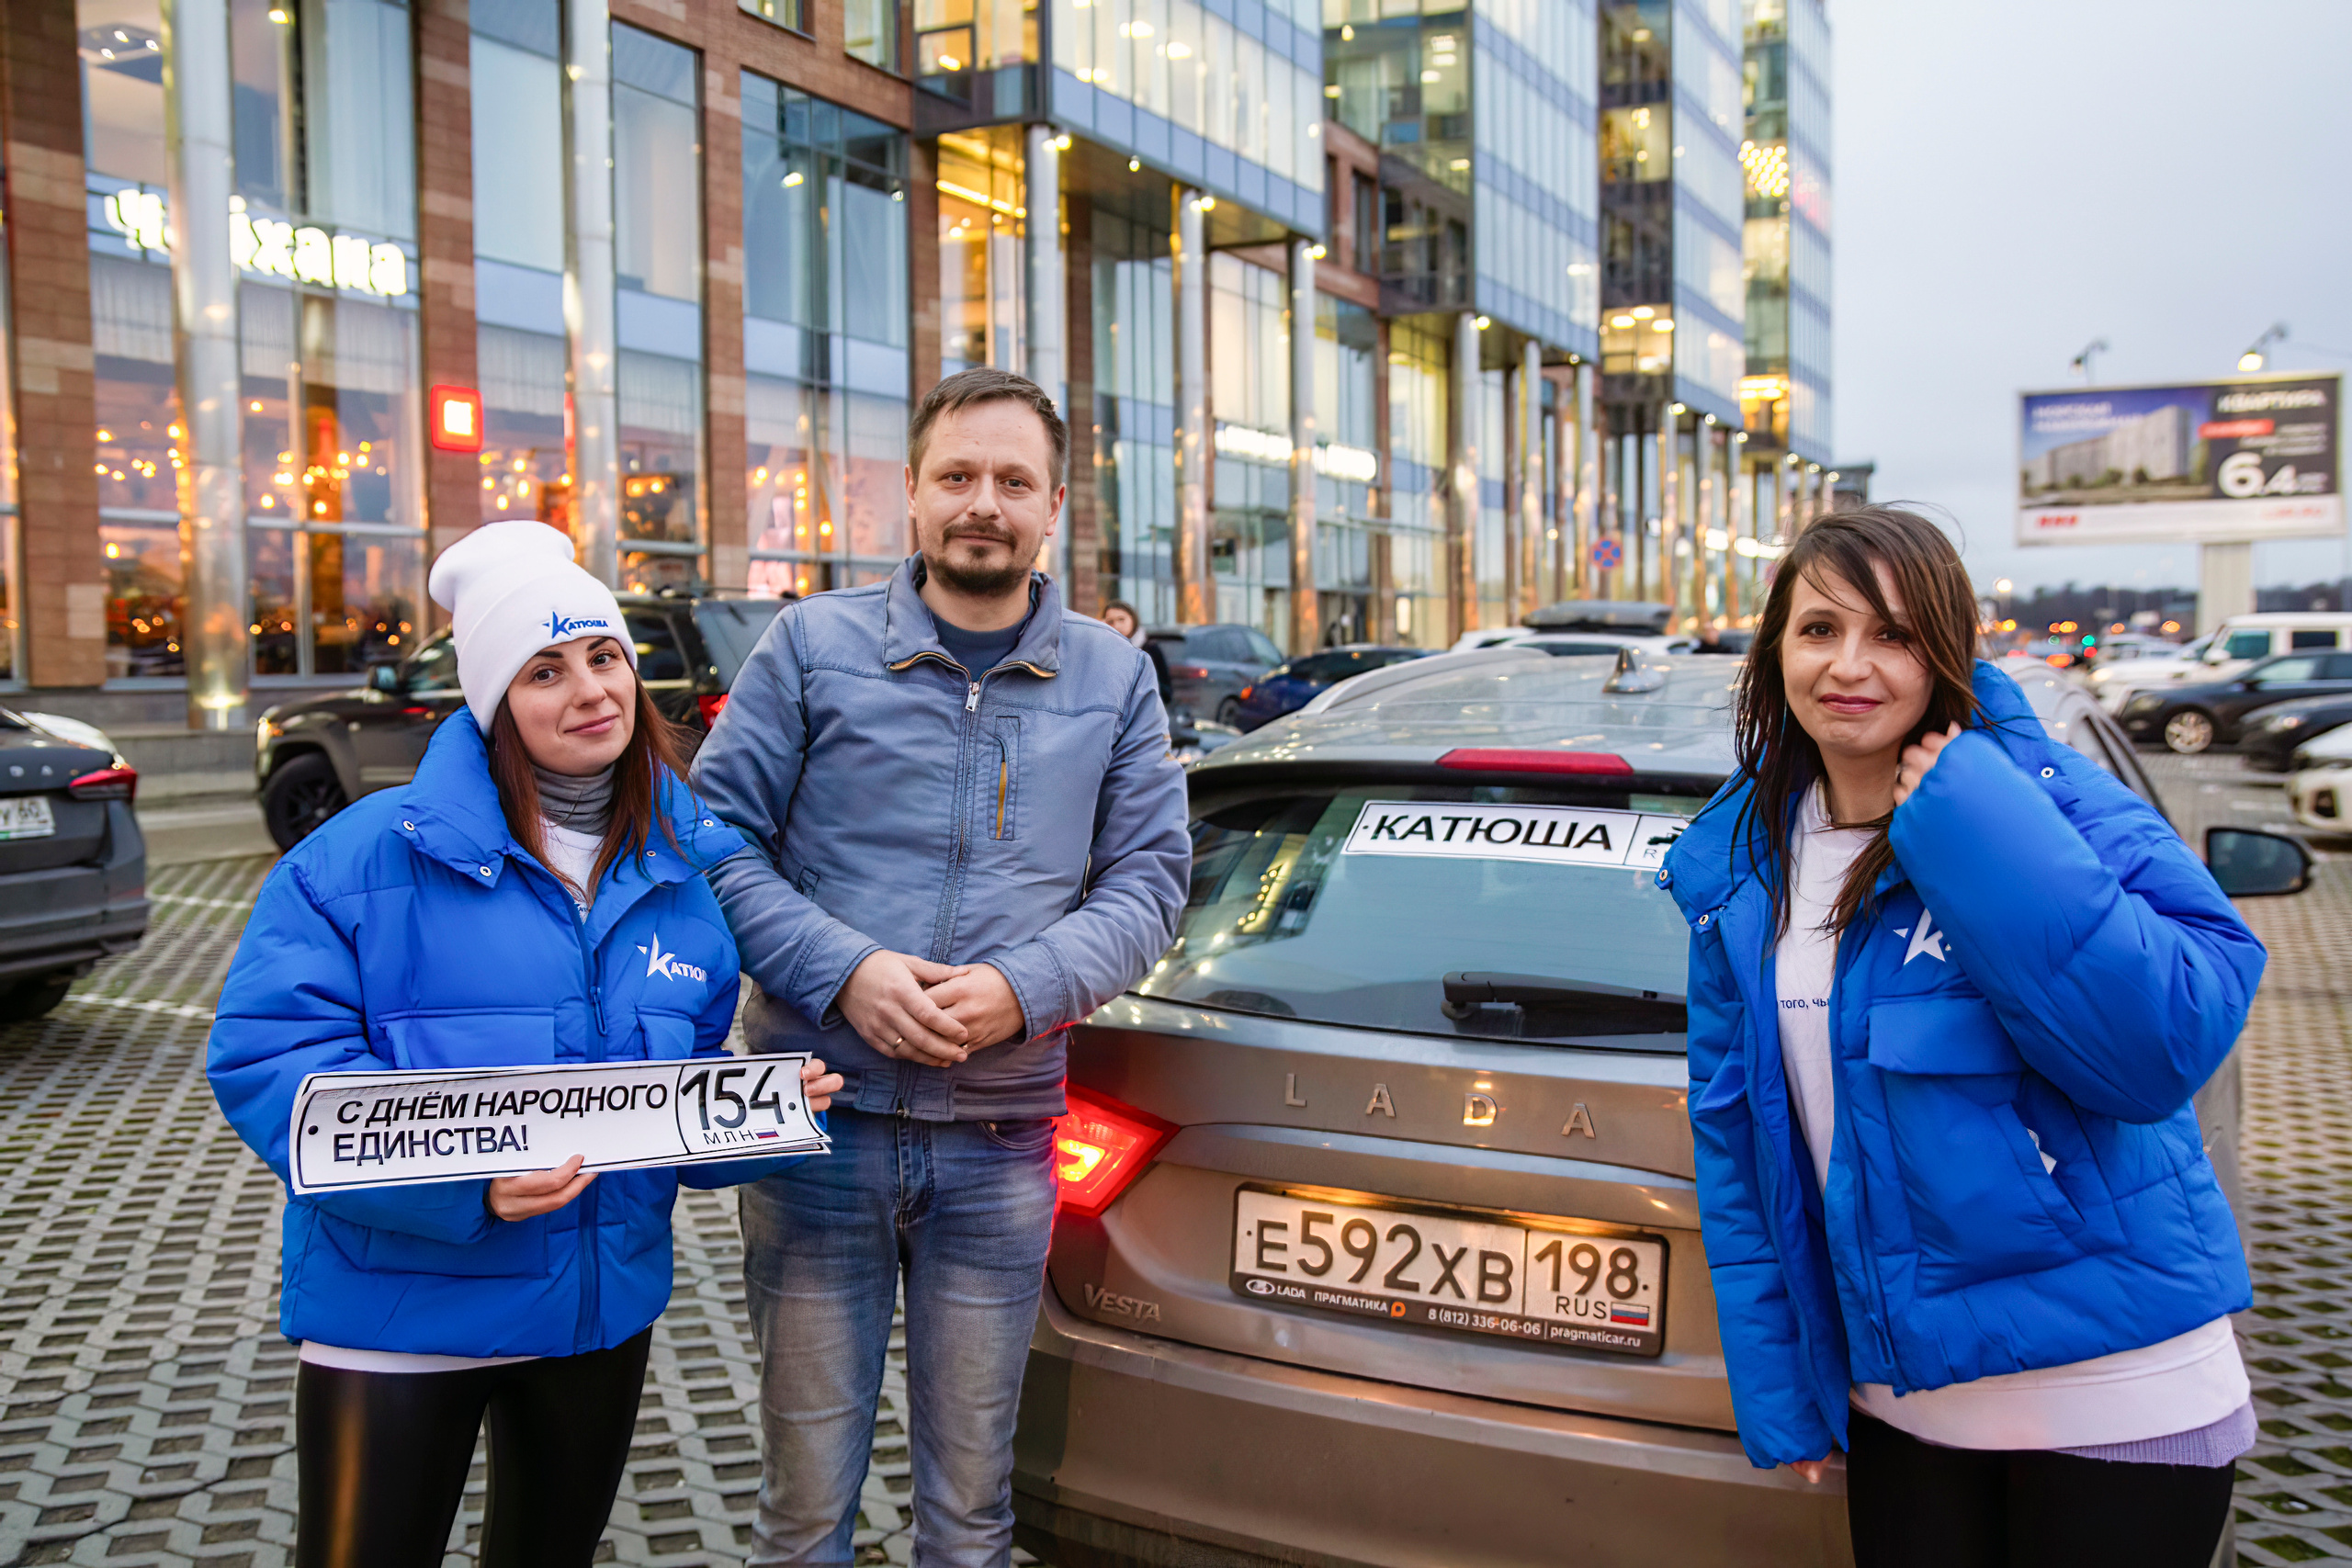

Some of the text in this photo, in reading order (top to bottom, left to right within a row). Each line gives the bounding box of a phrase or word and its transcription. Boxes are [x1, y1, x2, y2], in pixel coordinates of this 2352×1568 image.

[1370, 814, 1612, 852] КАТЮША
[1780, 998, 1809, 1010] того,
[336, 1082, 668, 1129] С ДНЁМ НАРОДНОГО
[679, 1065, 786, 1131] 154
[1285, 1072, 1597, 1140] LADA
[333, 1123, 529, 1167] ЕДИНСТВА!
[703, 1129, 755, 1145] МЛН
[1533, 1238, 1639, 1301] 198
[1084, 1283, 1161, 1324] VESTA
[1276, 1285, 1306, 1300] LADA
[1314, 1291, 1388, 1314] ПРАГМАТИКА
[1555, 1295, 1608, 1321] RUS
[1428, 1308, 1542, 1336] 8 (812) 336-06-06
[1550, 1325, 1641, 1348] pragmaticar.ru
